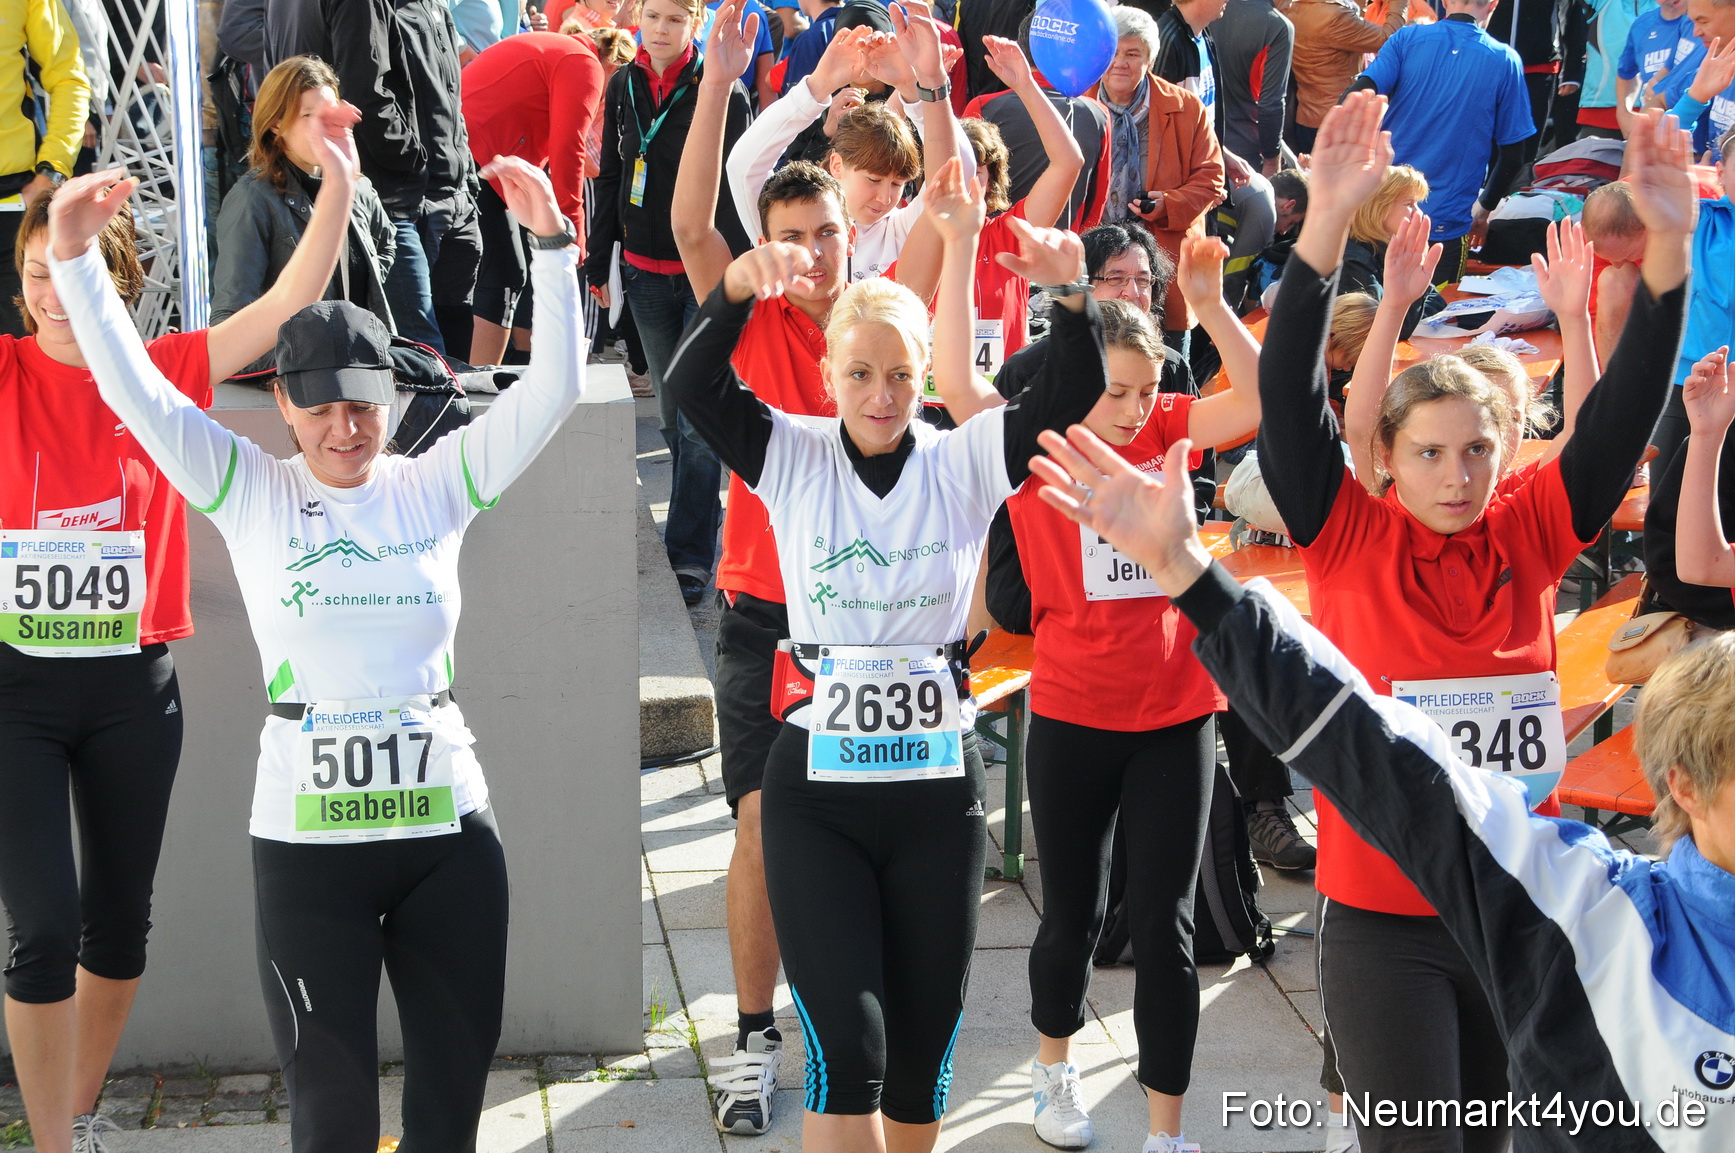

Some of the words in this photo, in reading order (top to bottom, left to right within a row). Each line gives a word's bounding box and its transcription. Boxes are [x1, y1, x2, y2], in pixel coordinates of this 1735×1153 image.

[1031, 16, 1079, 35] BOCK
[61, 511, 99, 528] DEHN
[21, 541, 86, 552] PFLEIDERER
[101, 545, 135, 555] BOCK
[889, 540, 949, 563] ENSTOCK
[15, 564, 130, 610] 5049
[311, 593, 391, 606] ...schneller
[396, 594, 421, 605] ans
[831, 598, 894, 612] ...schneller
[896, 598, 916, 610] ans
[920, 592, 951, 607] Ziel!!!
[18, 614, 123, 640] Susanne
[836, 658, 894, 671] PFLEIDERER
[834, 671, 895, 679] AKTIENGESELLSCHAFT
[826, 679, 943, 733] 2639
[1419, 691, 1495, 707] PFLEIDERER
[1511, 690, 1546, 704] BOCK
[315, 710, 383, 725] PFLEIDERER
[316, 723, 385, 731] AKTIENGESELLSCHAFT
[839, 737, 930, 764] Sandra
[1436, 714, 1547, 772] 348
[312, 732, 433, 789] 5017
[320, 791, 430, 822] Isabella
